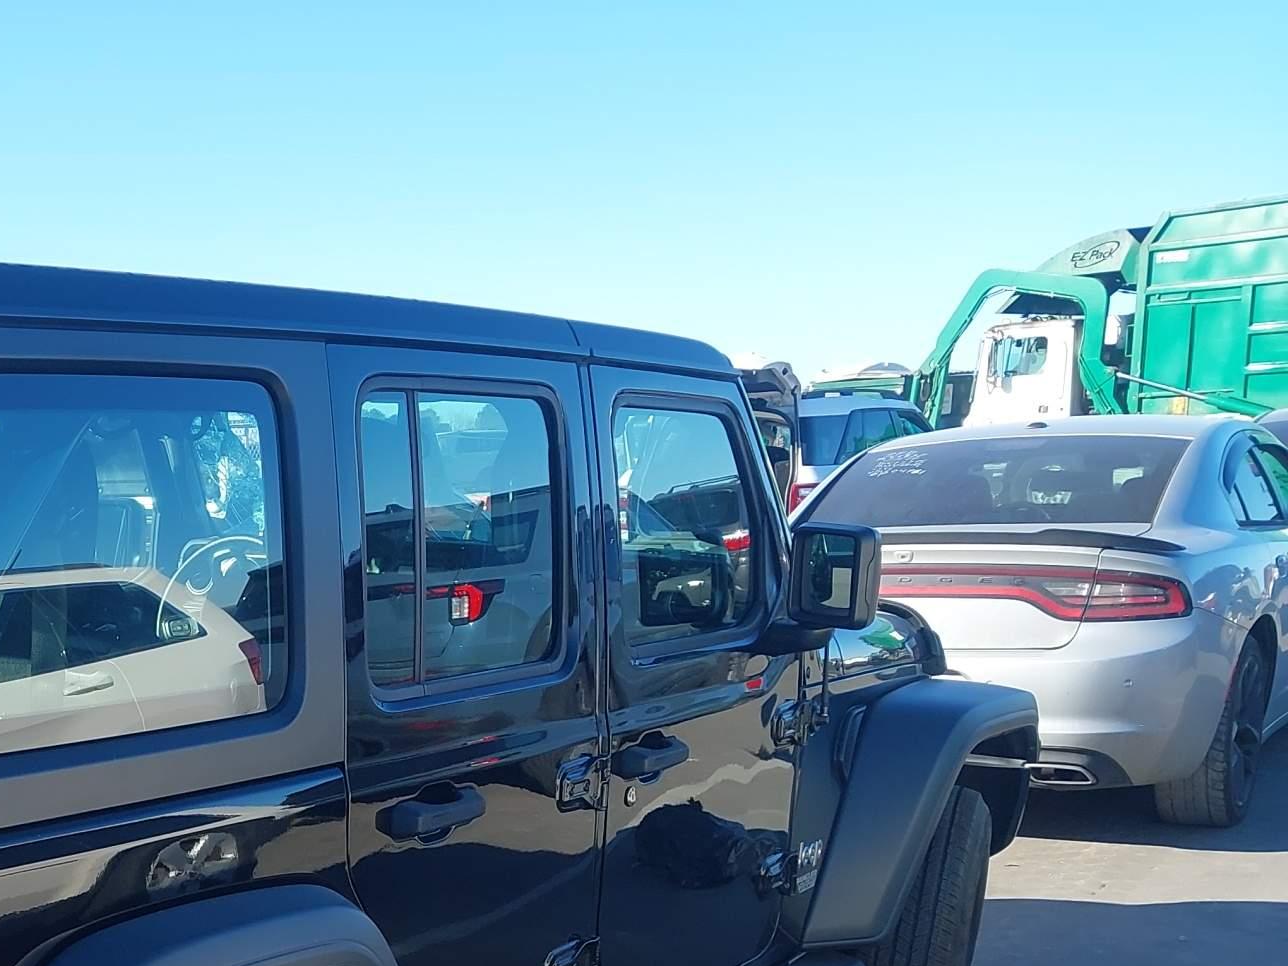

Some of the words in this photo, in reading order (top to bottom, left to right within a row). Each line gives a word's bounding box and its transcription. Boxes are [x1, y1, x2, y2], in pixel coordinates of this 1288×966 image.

[1071, 251, 1088, 262] EZ
[1089, 248, 1114, 261] Pack
[898, 575, 994, 585] DGE
[798, 839, 824, 869] Jeep
